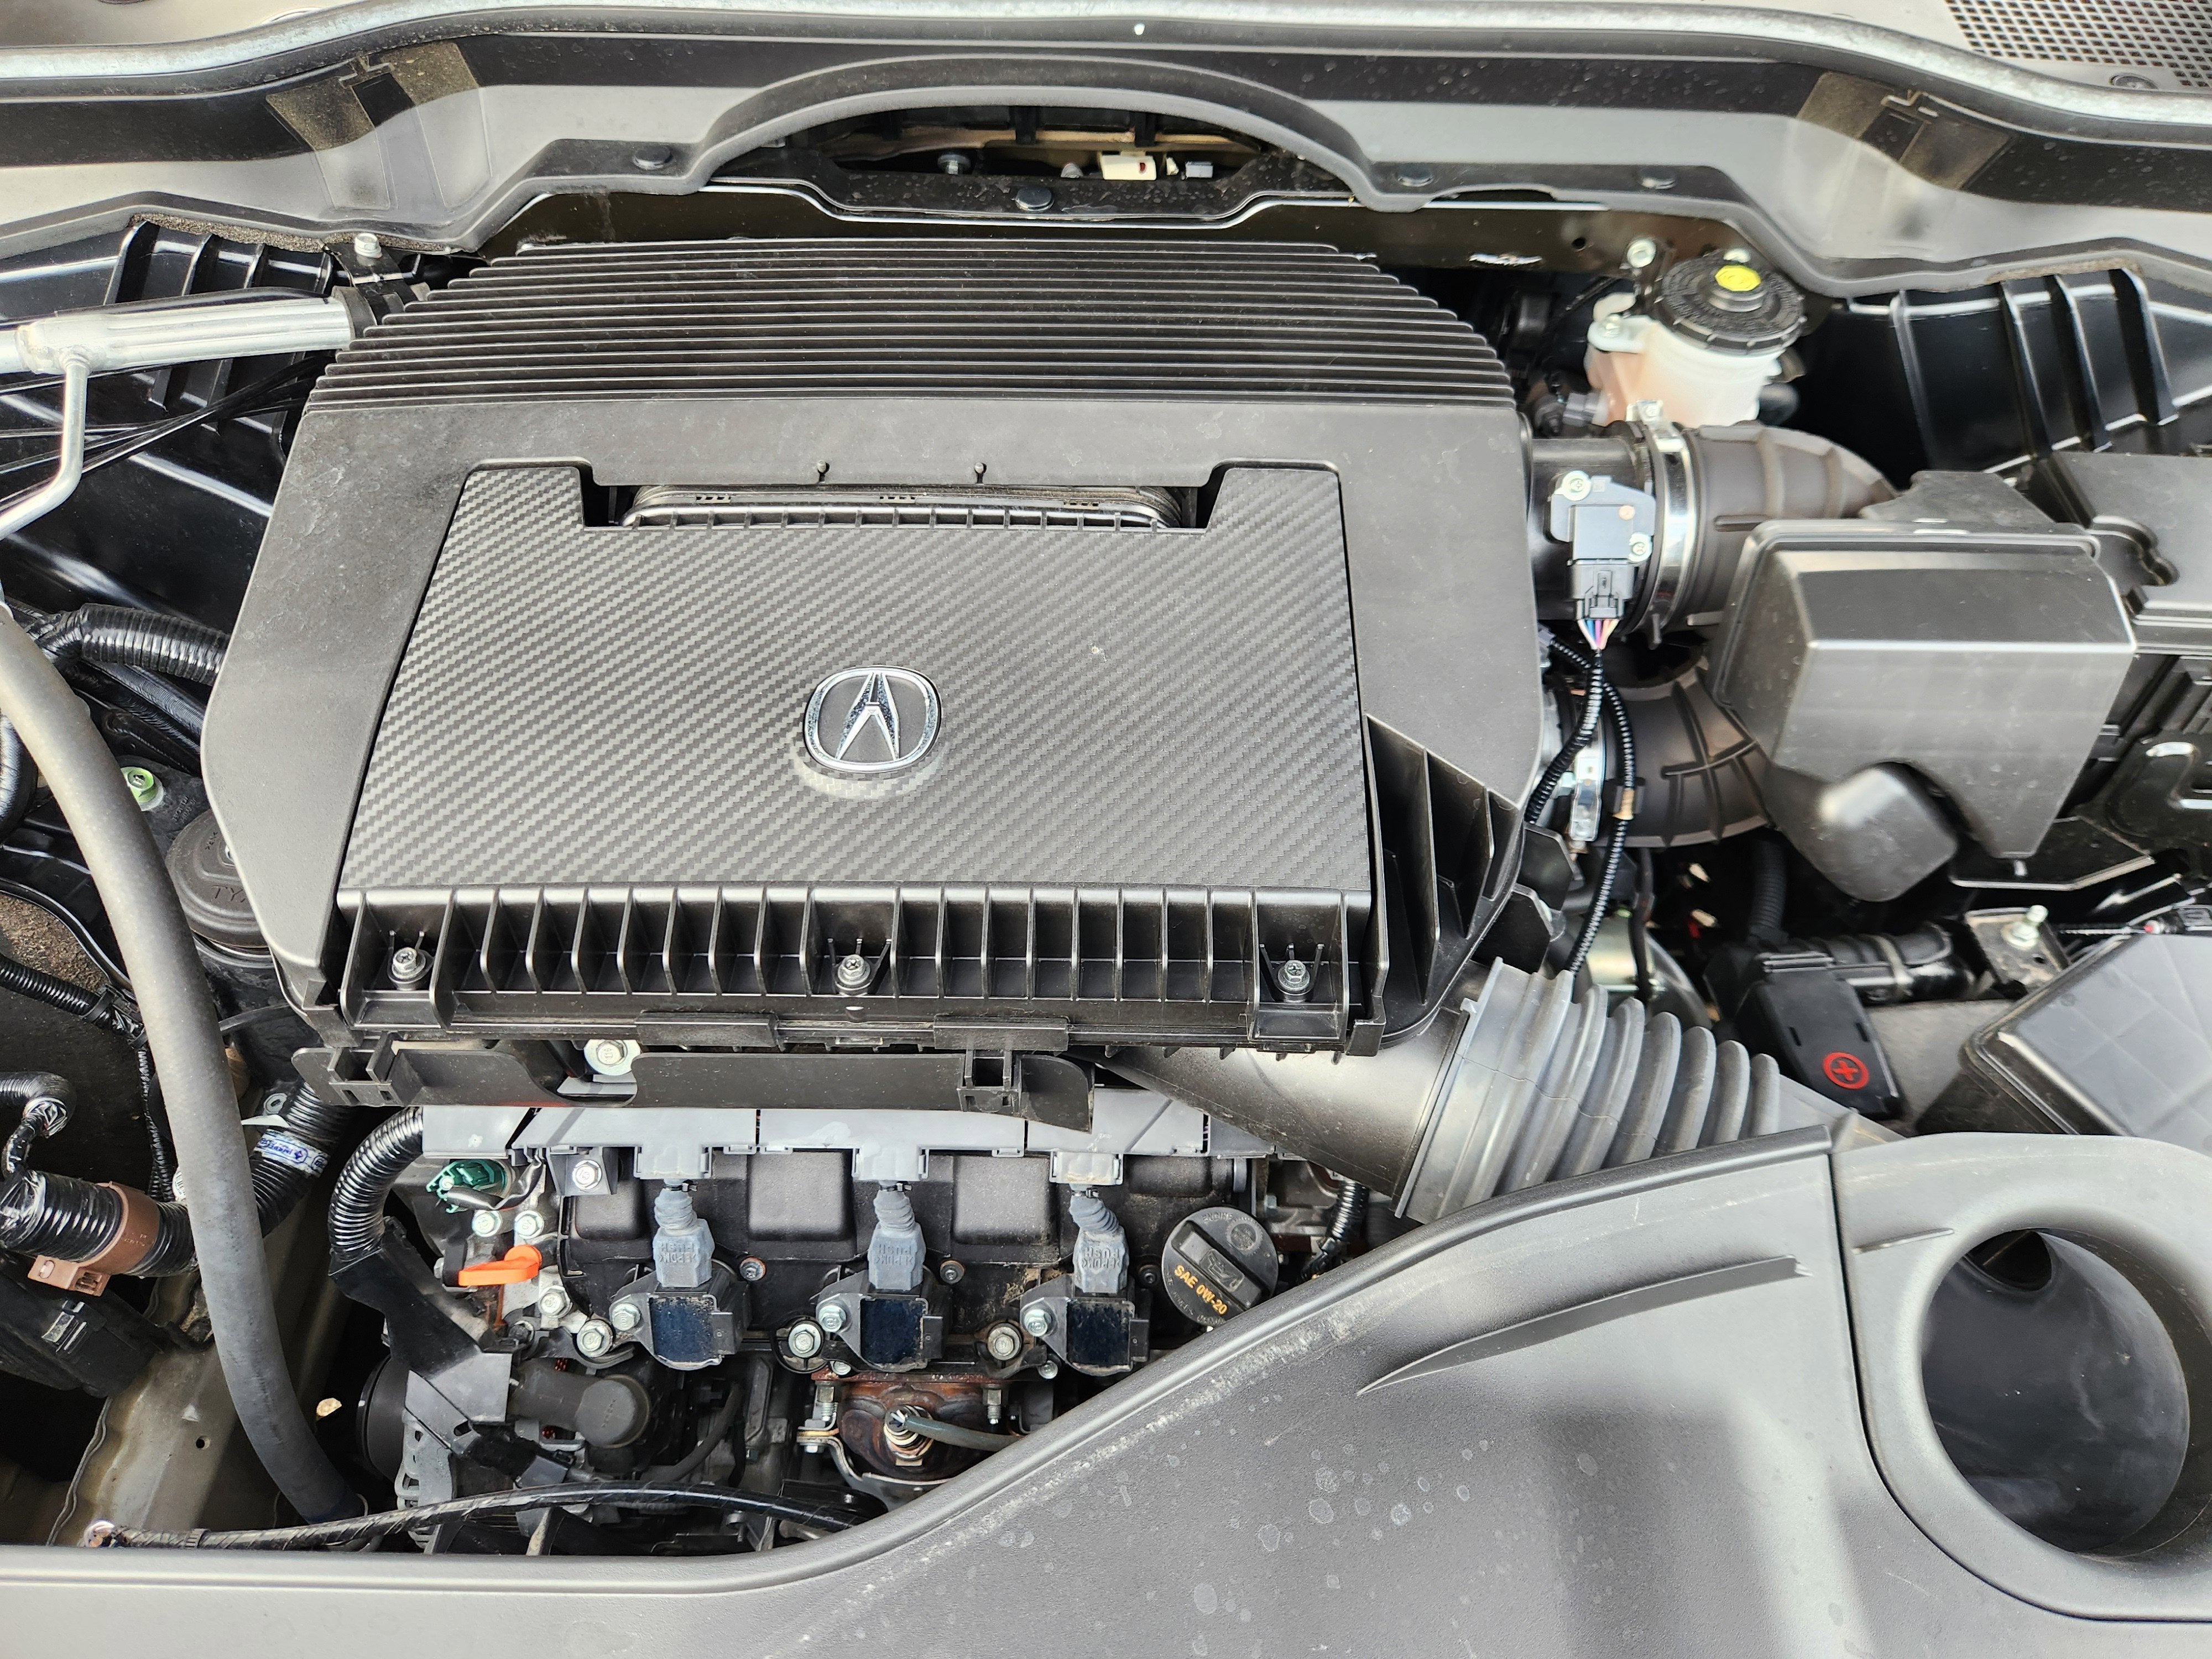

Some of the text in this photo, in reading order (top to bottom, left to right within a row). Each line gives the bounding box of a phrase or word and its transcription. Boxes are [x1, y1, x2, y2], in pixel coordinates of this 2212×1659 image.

[210, 885, 246, 902] TY
[878, 1244, 912, 1255] PUSH
[1084, 1246, 1120, 1259] PUSH
[1174, 1265, 1198, 1289] SAE
[1196, 1284, 1228, 1315] 0W-20
